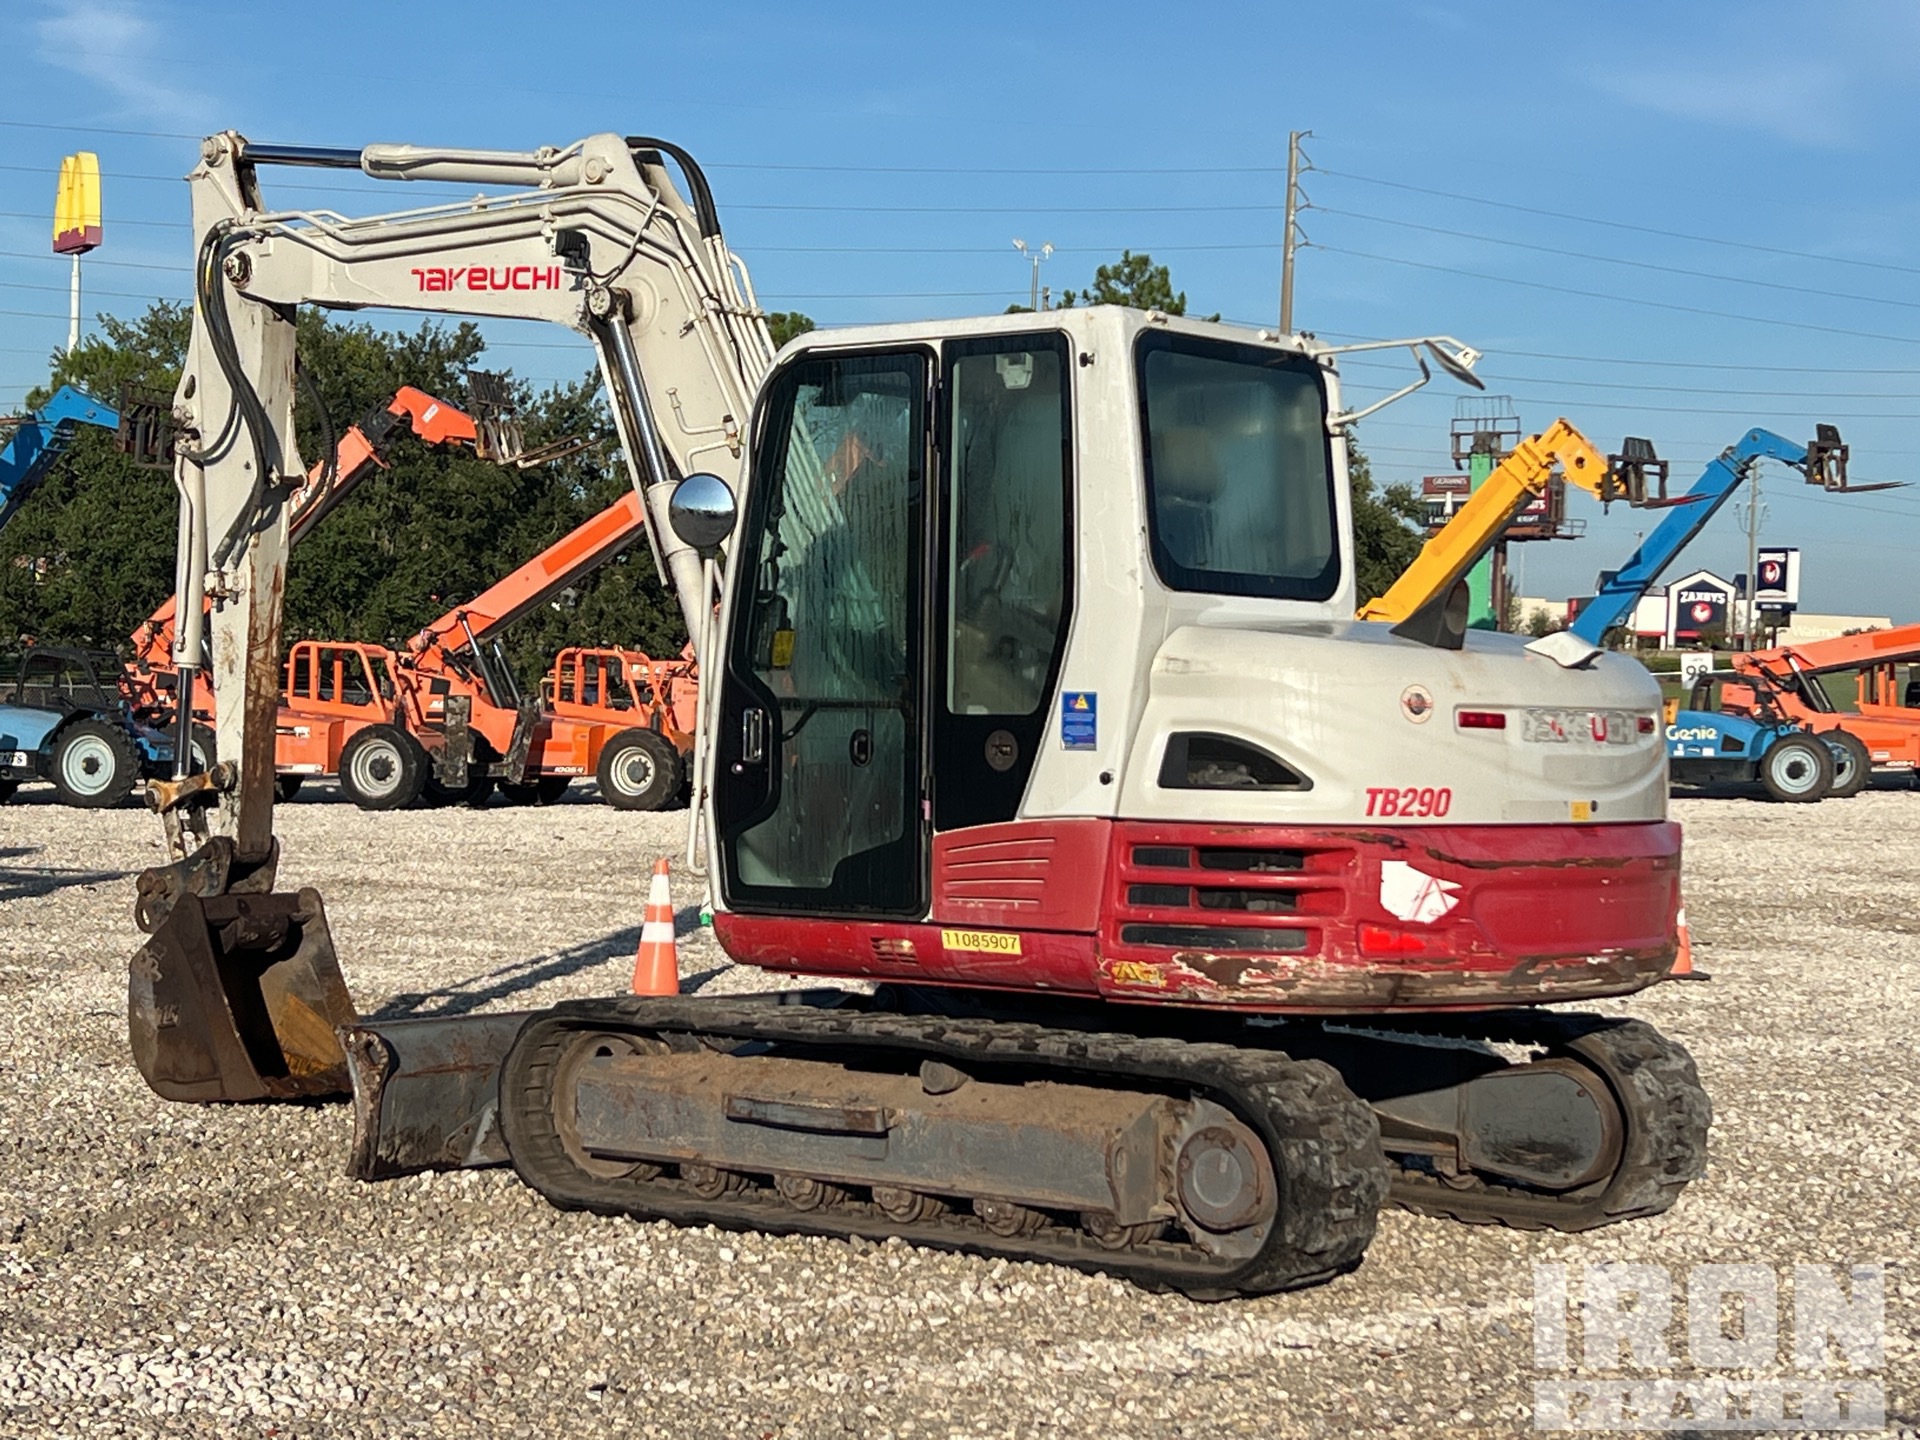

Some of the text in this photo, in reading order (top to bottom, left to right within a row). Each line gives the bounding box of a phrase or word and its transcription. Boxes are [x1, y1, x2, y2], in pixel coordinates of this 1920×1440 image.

[1665, 724, 1718, 741] Genie
[1365, 787, 1452, 818] TB290
[944, 932, 1018, 951] 11085907
